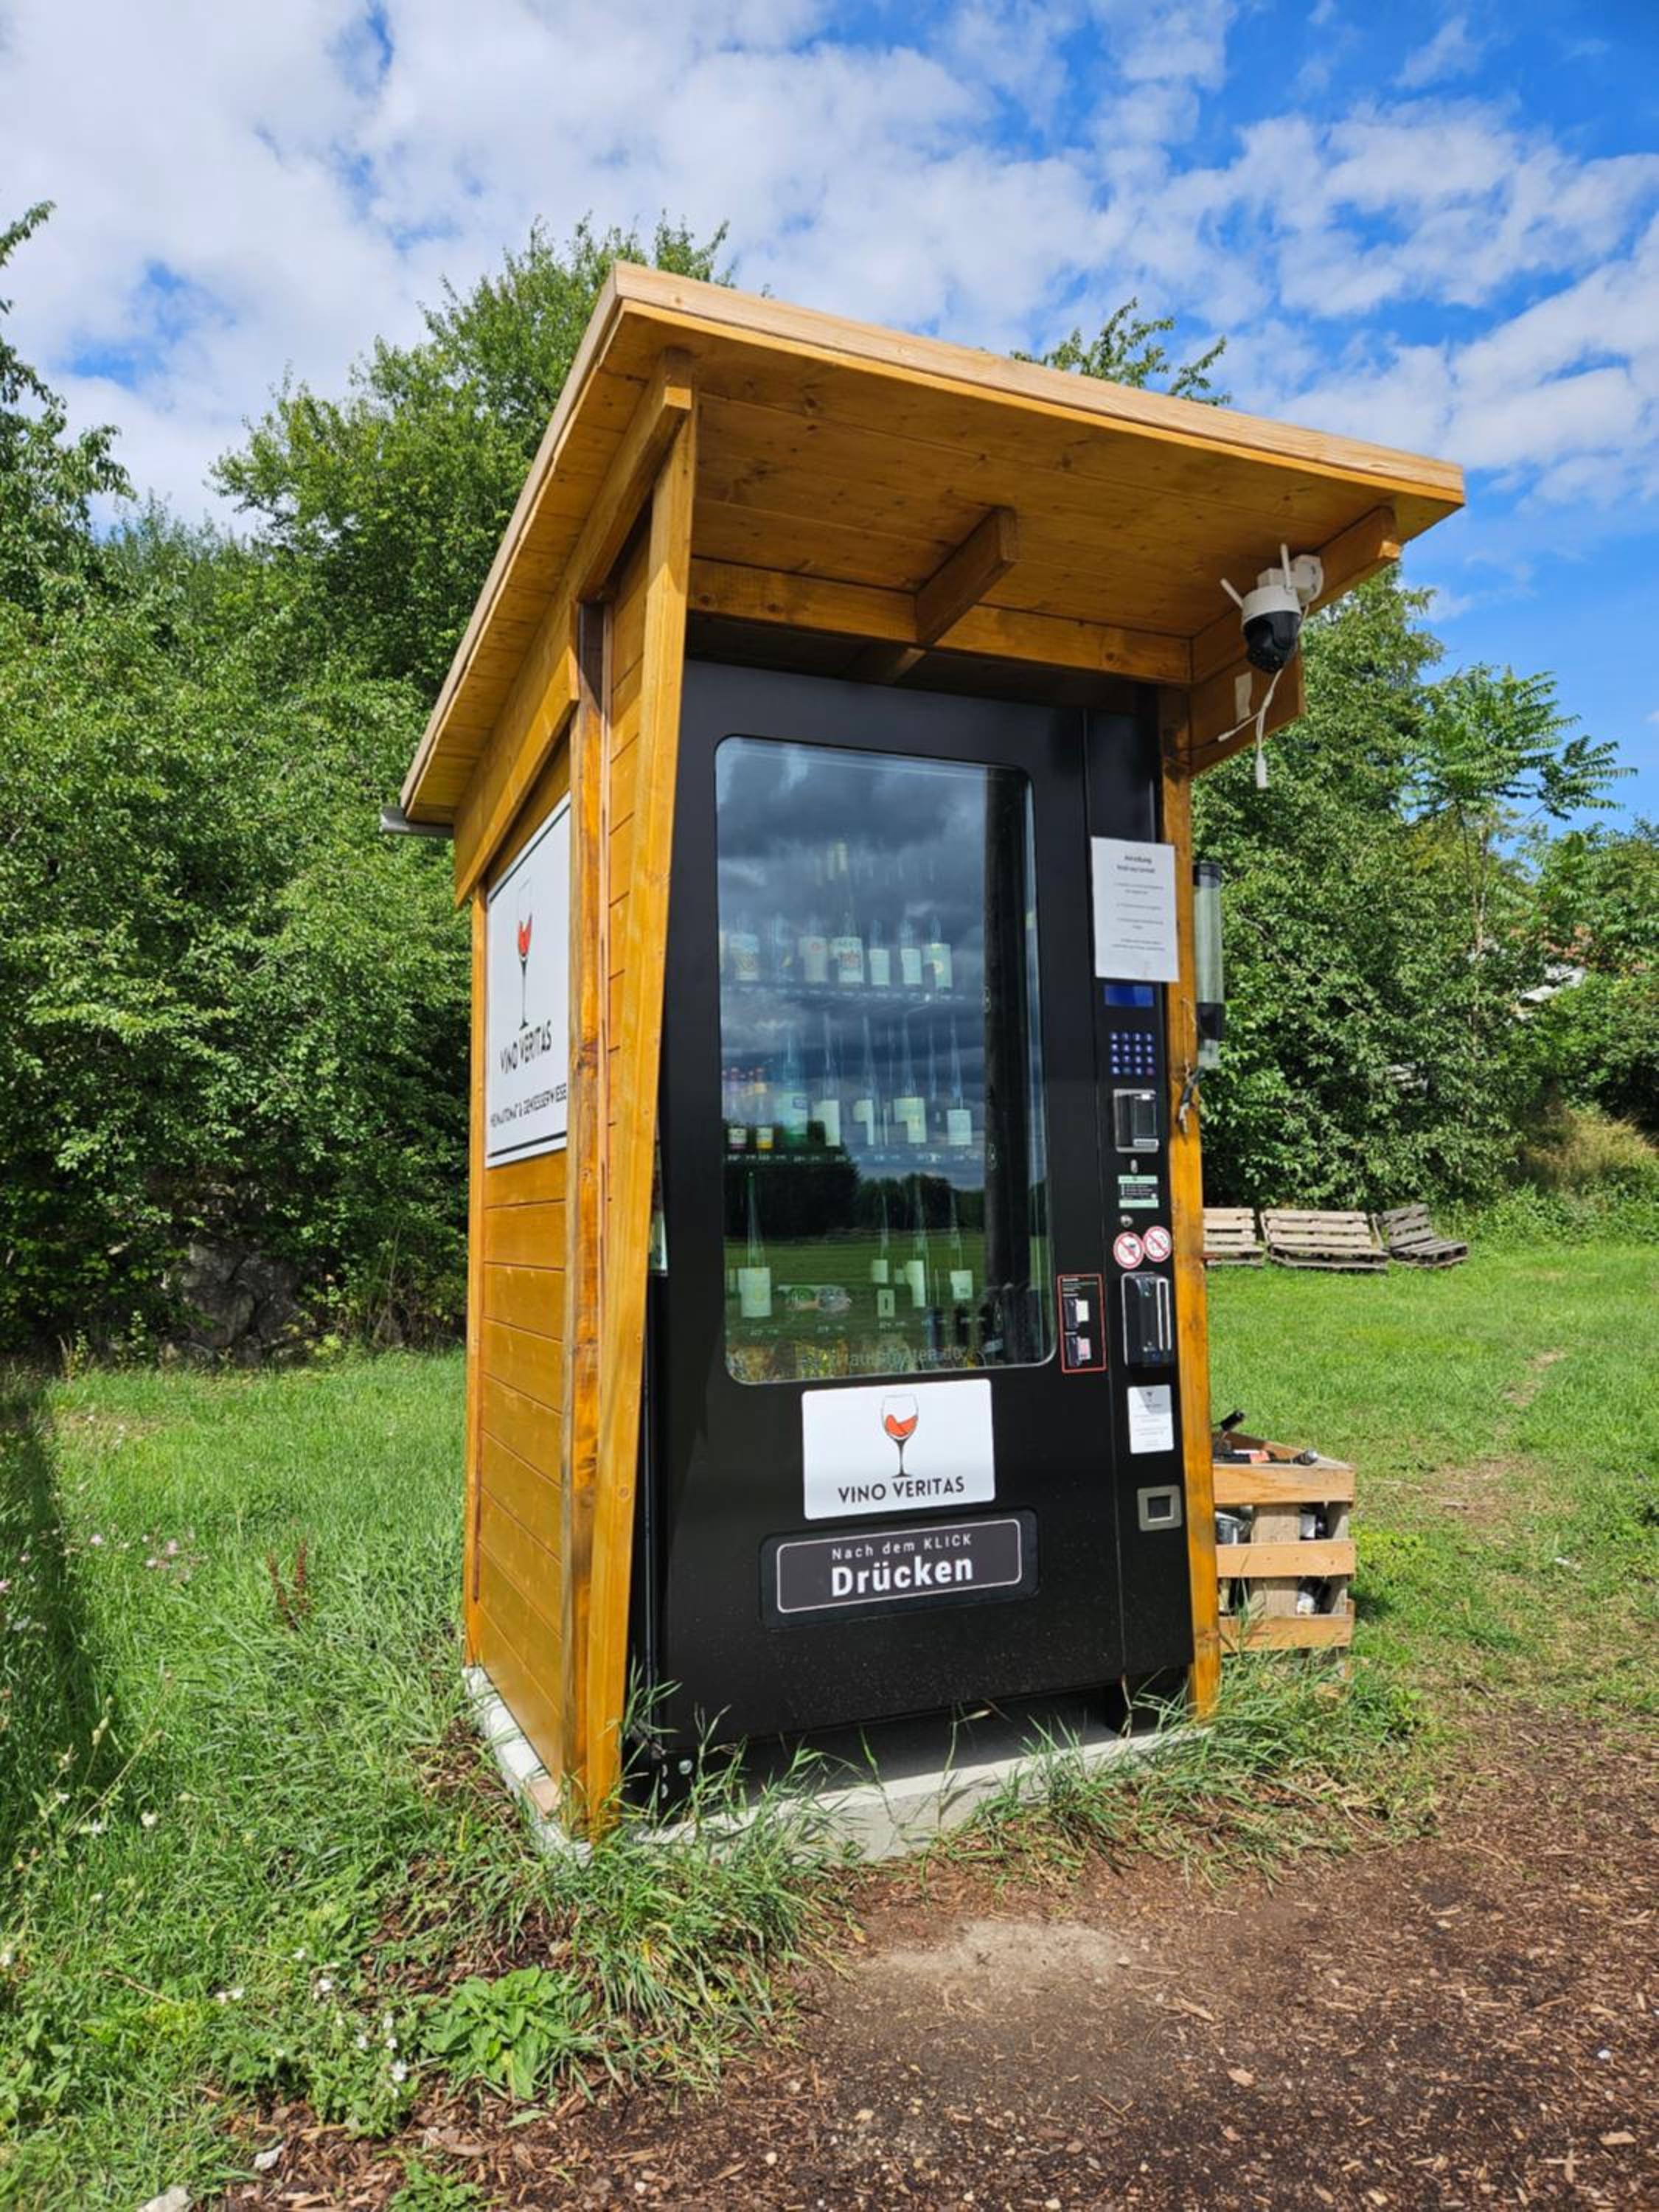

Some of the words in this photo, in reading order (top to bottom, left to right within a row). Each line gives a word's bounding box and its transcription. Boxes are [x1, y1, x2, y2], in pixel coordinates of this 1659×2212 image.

[838, 1484, 886, 1503] VINO
[893, 1477, 964, 1498] VERITAS
[832, 1545, 873, 1559] Nach
[882, 1541, 915, 1555] dem
[924, 1534, 972, 1550] KLICK
[831, 1556, 973, 1596] Drücken
